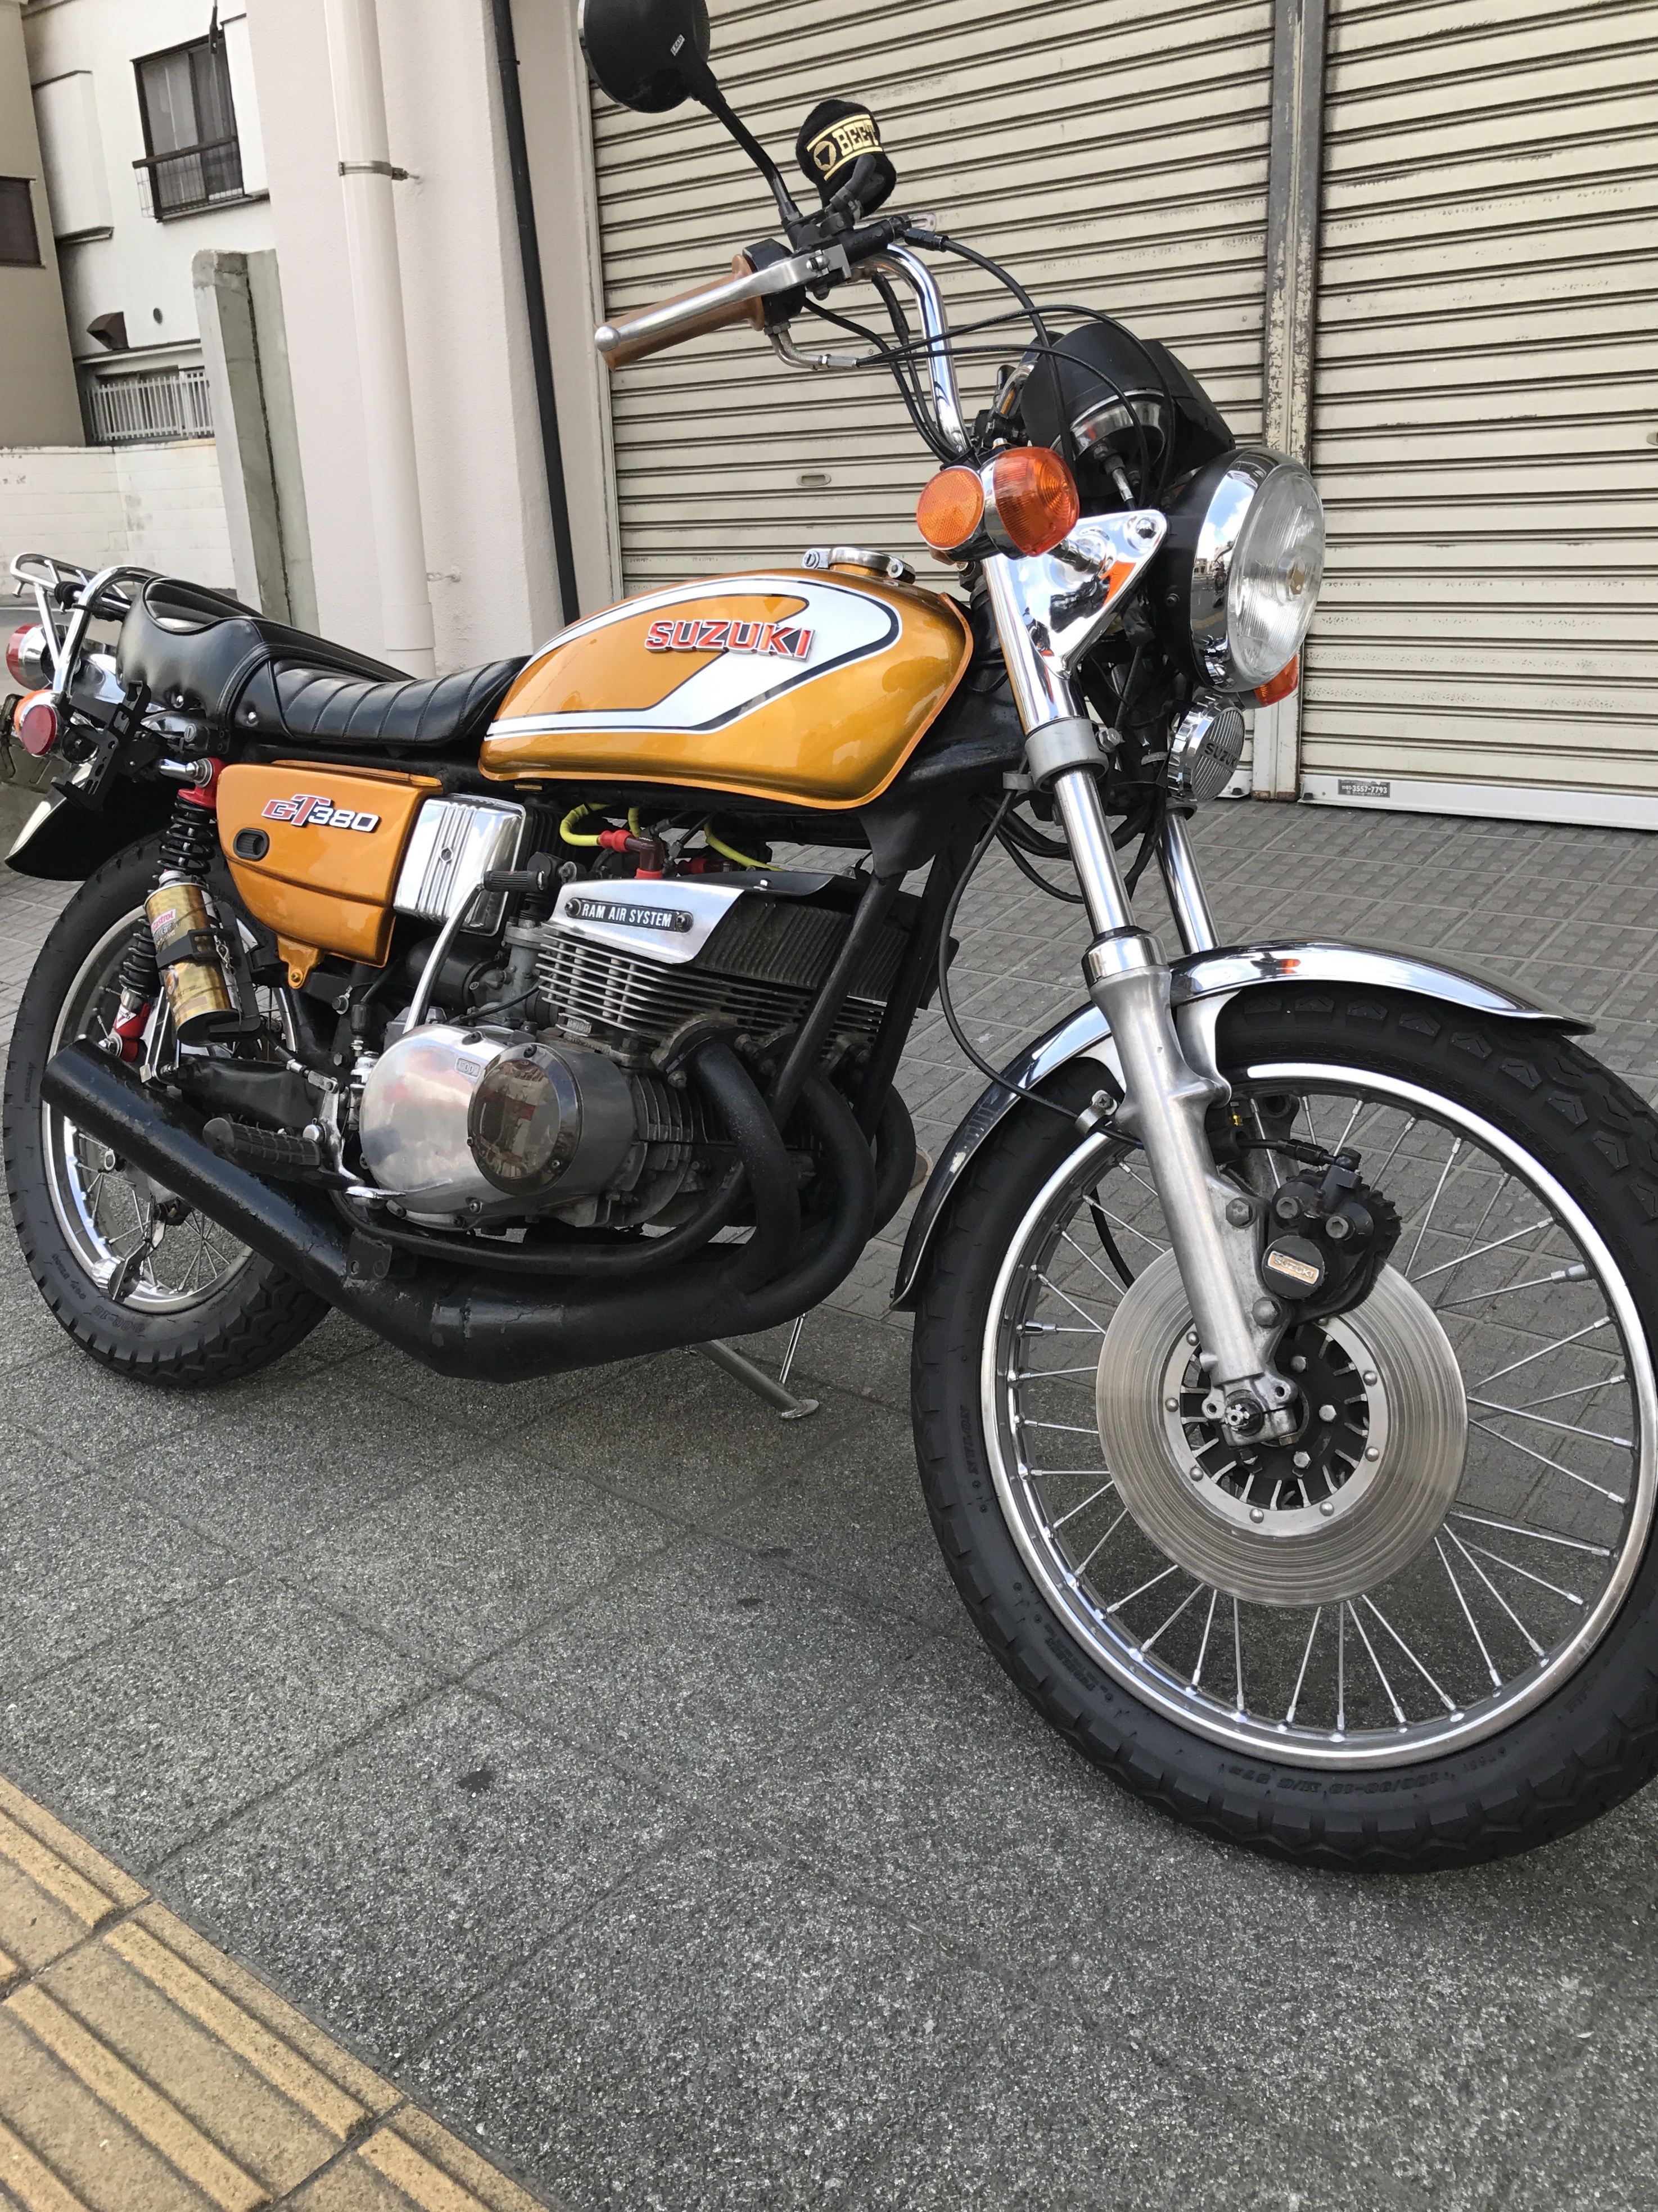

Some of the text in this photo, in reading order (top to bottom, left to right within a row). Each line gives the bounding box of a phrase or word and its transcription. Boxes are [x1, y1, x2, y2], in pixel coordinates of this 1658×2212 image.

[832, 119, 879, 156] BEET
[644, 620, 815, 662] SUZUKI
[261, 794, 379, 832] GT380
[153, 911, 174, 931] Castrol
[582, 904, 672, 928] RAM AIR SYSTEM
[1274, 1255, 1314, 1279] SUZUKI
